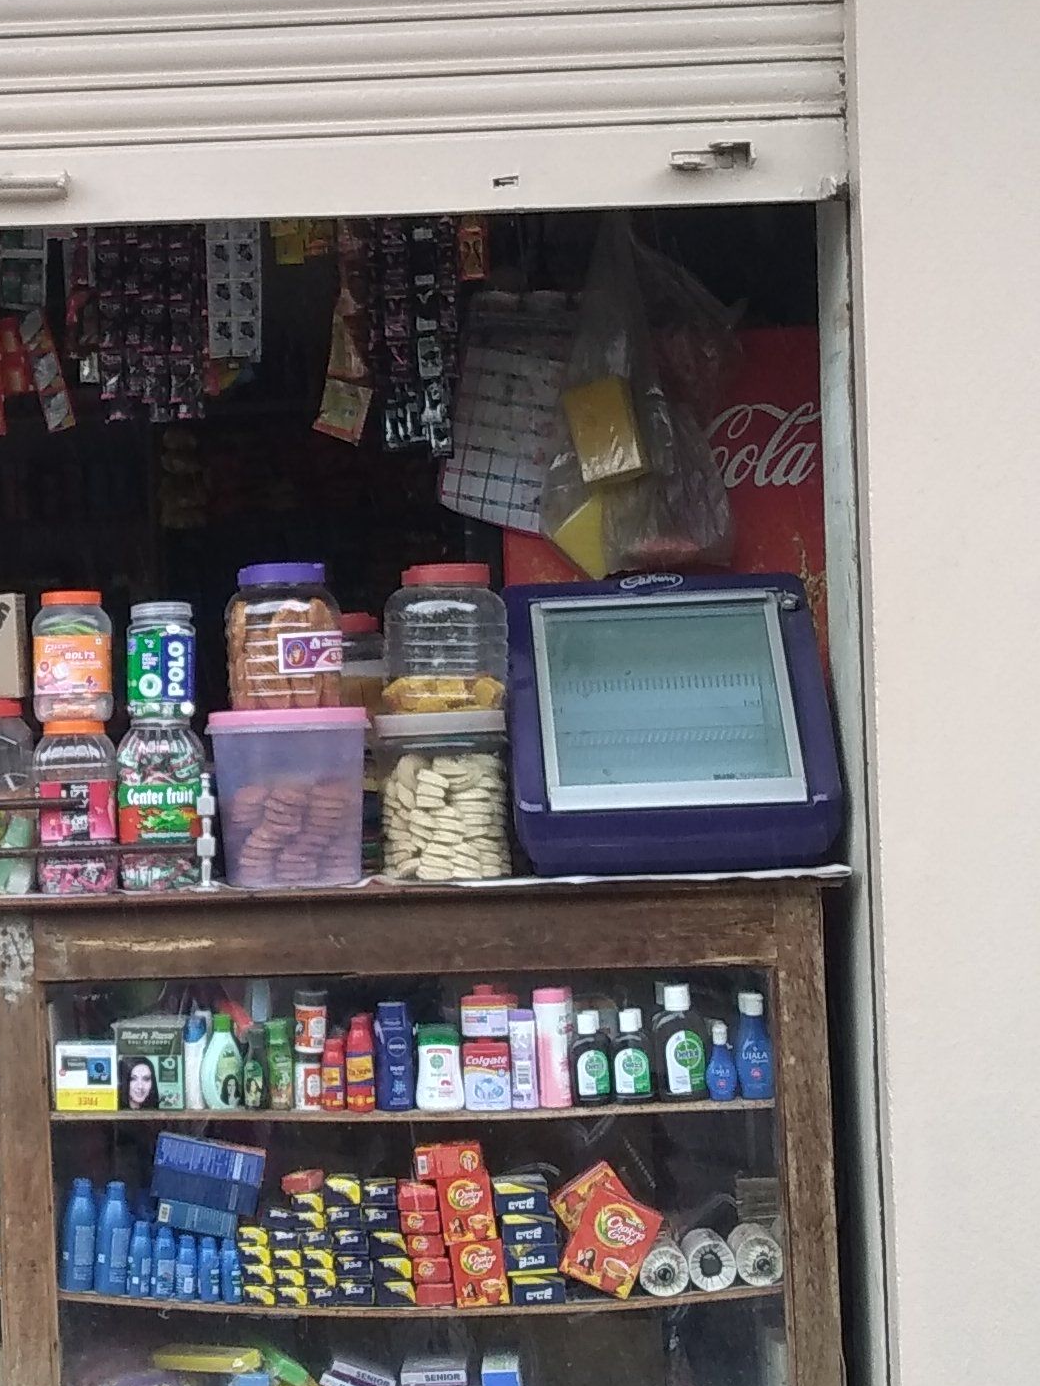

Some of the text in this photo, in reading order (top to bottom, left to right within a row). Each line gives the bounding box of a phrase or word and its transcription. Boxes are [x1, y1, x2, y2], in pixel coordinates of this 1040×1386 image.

[167, 641, 185, 697] POLO
[127, 786, 194, 805] Center fruit
[676, 1049, 700, 1059] Dettol
[465, 1056, 508, 1067] Colgate
[425, 1373, 460, 1381] SENIOR
